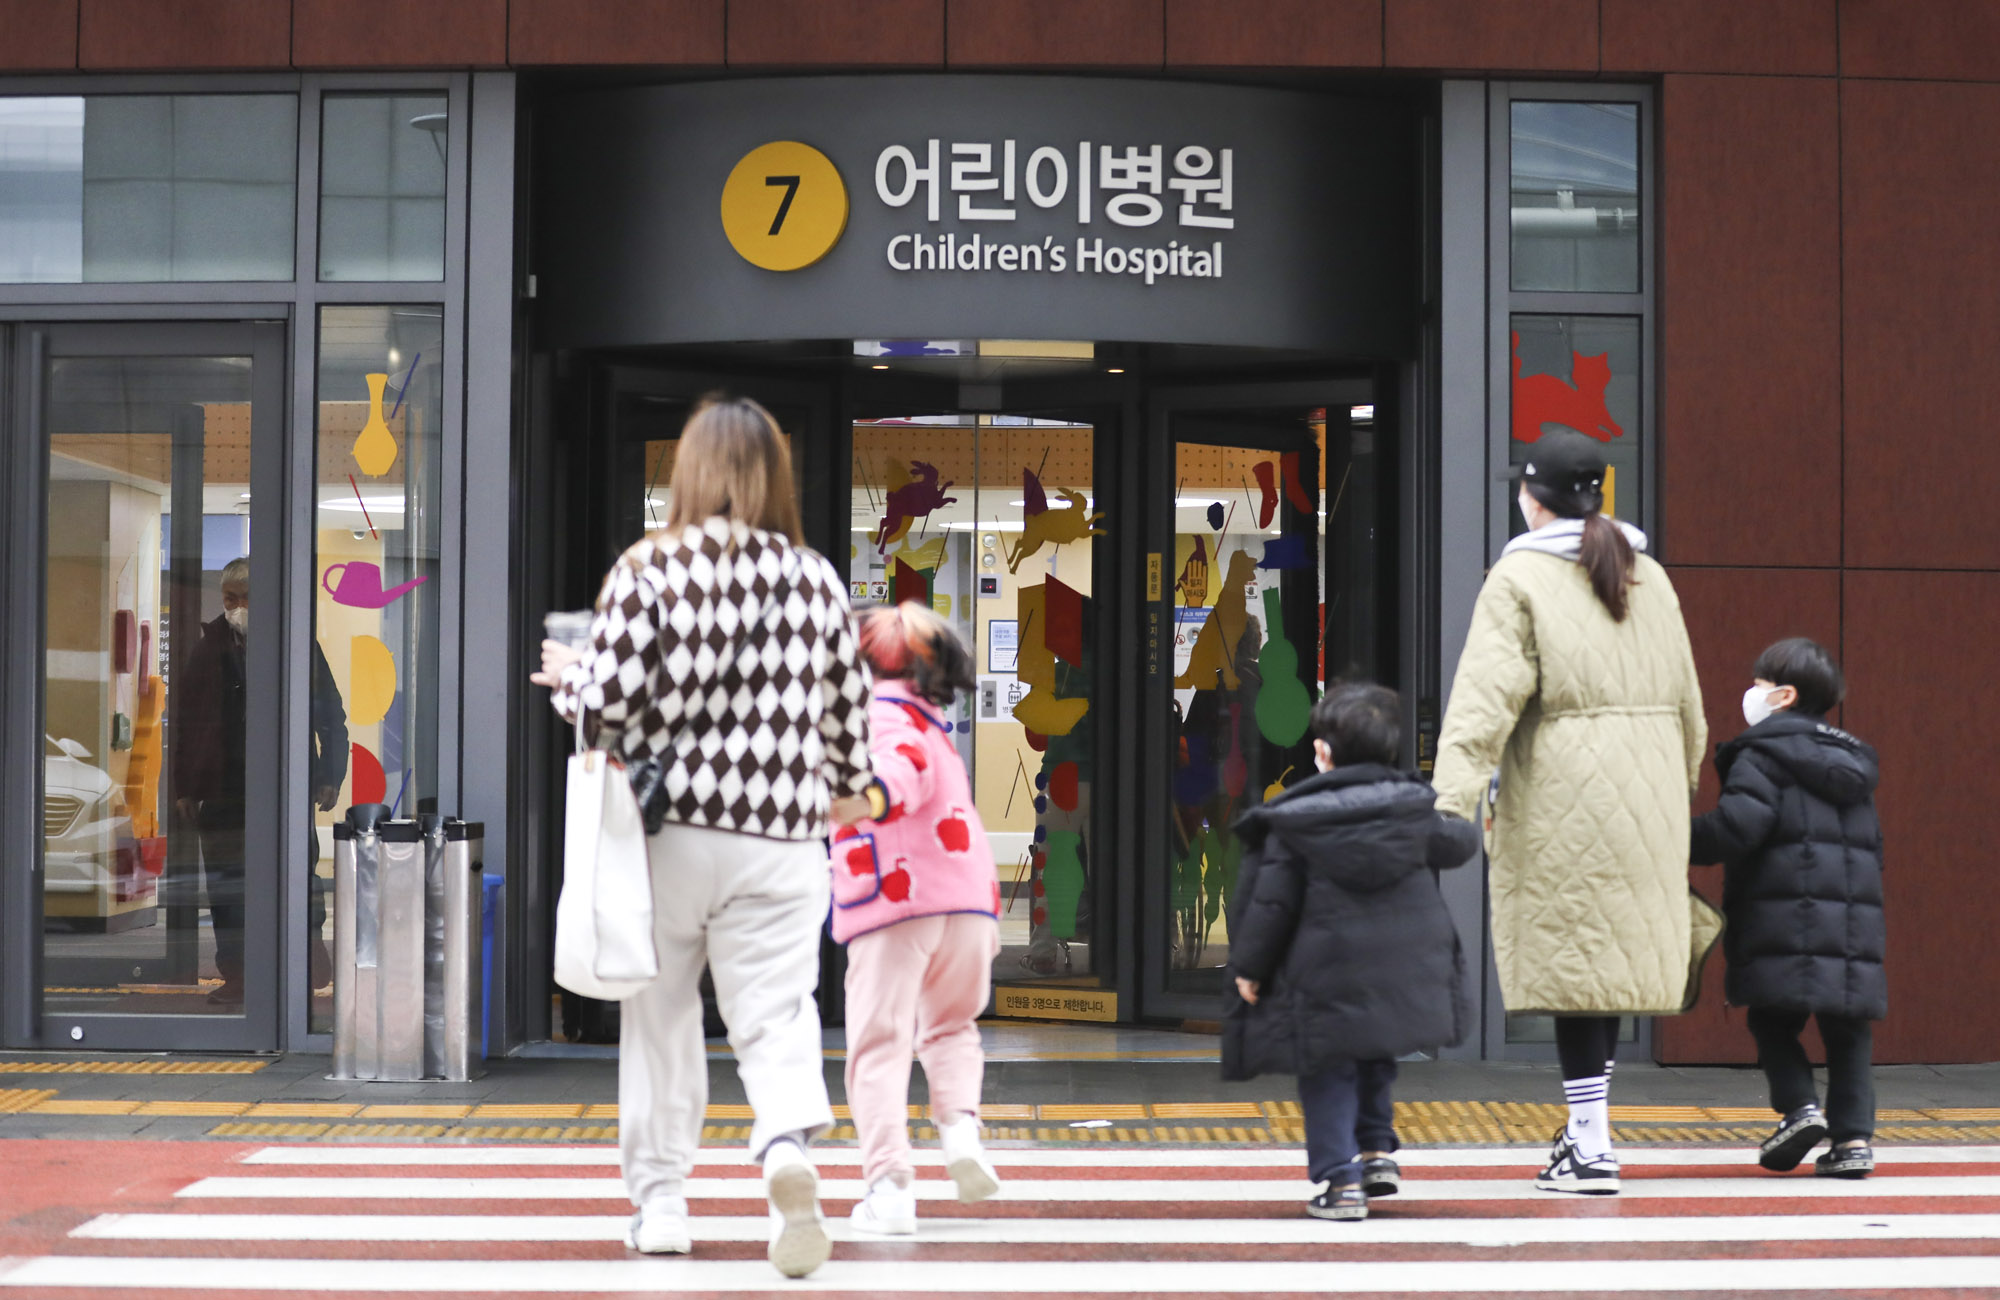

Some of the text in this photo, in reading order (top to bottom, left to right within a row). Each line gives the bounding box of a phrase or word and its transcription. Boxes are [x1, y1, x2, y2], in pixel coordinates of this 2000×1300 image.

[874, 138, 1235, 230] 어린이병원
[764, 175, 801, 236] 7
[886, 233, 1223, 285] Children's Hospital
[1150, 560, 1159, 595] 자동문
[1186, 588, 1205, 598] 마시오
[1190, 578, 1203, 588] 밀지
[1006, 996, 1106, 1013] 인원을 3명으로 제한합니다.
